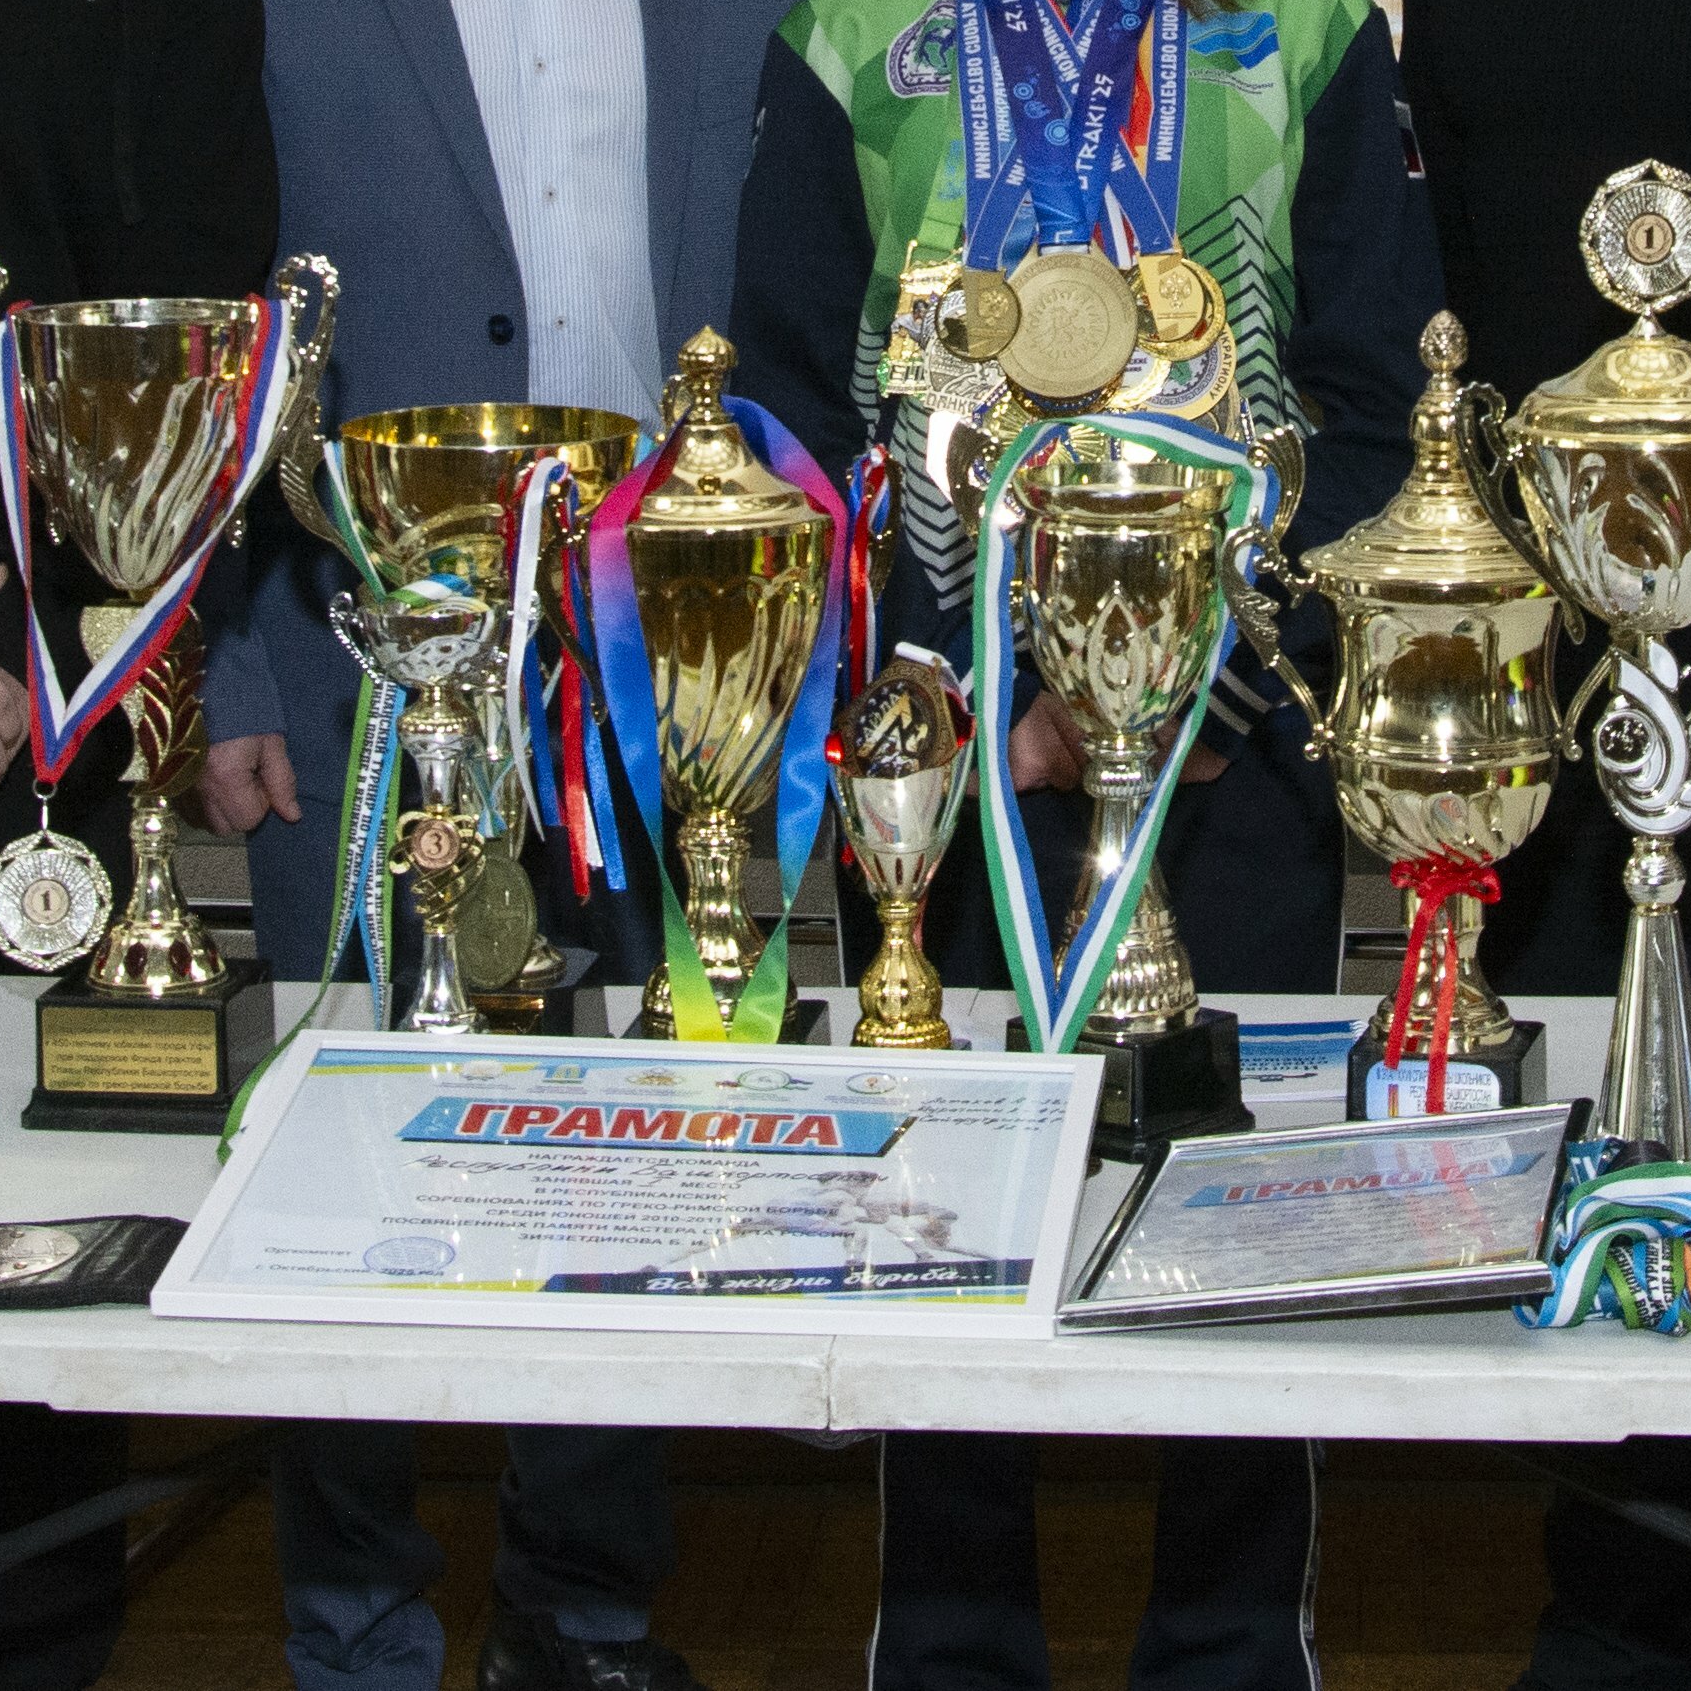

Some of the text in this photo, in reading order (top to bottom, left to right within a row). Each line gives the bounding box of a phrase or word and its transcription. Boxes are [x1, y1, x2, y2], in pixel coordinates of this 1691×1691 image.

[1644, 226, 1655, 249] 1
[427, 832, 442, 856] 3
[40, 889, 52, 912] 1
[456, 1101, 843, 1148] ГРАМОТА
[528, 1153, 761, 1168] НАГРАЖДАЕТСЯ КОМАНДА
[530, 1175, 633, 1186] ЗАНЯВШАЯ
[680, 1181, 742, 1190] МЕСТО
[1223, 1160, 1492, 1203] ГРАМОТА
[415, 1194, 574, 1207] СОРЕВНОВАНИЯХ
[580, 1200, 606, 1208] ПО
[534, 1187, 728, 1201] В РЕСПУБЛИКАНСКИХ
[485, 1208, 546, 1218] СРЕДИ
[551, 1211, 637, 1221] ЮНОШЕЙ
[533, 1221, 609, 1231] ПАМЯТИ
[613, 1224, 697, 1235] МАСТЕРА
[263, 1245, 352, 1257] Оргкомитет
[720, 1275, 832, 1293] жизнь
